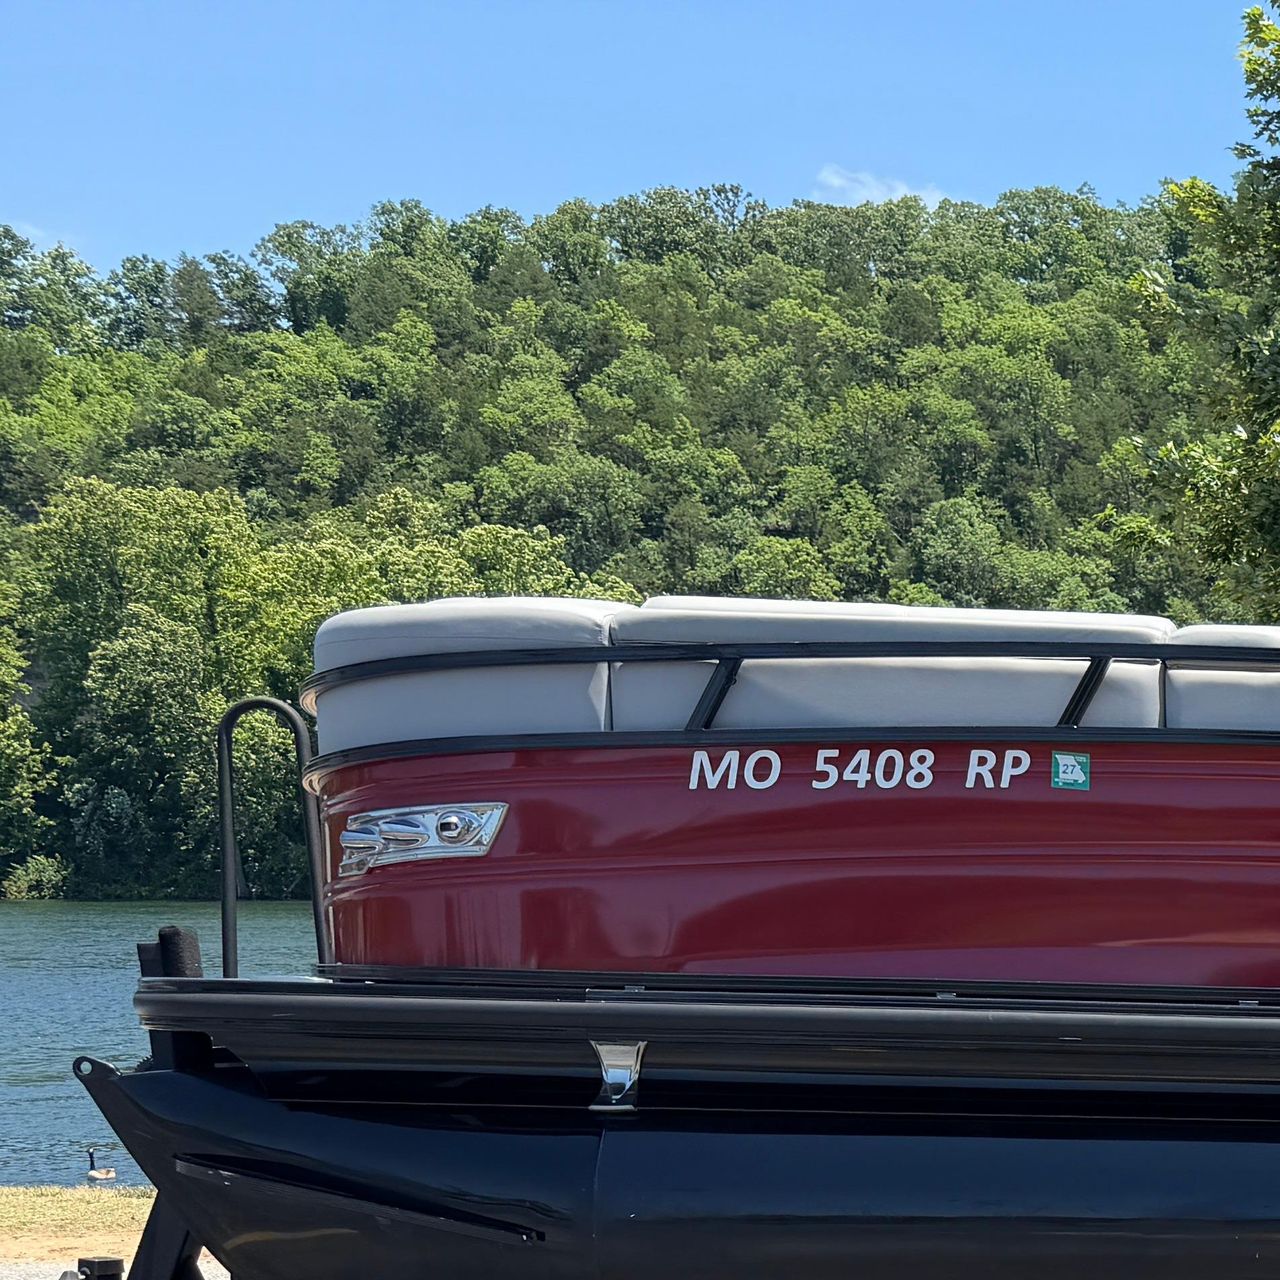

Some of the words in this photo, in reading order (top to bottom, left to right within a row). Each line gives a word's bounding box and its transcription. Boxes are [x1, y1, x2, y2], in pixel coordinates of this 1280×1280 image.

[688, 749, 782, 791] MO
[811, 748, 935, 790] 5408
[965, 749, 1031, 789] RP
[1062, 763, 1077, 775] 27
